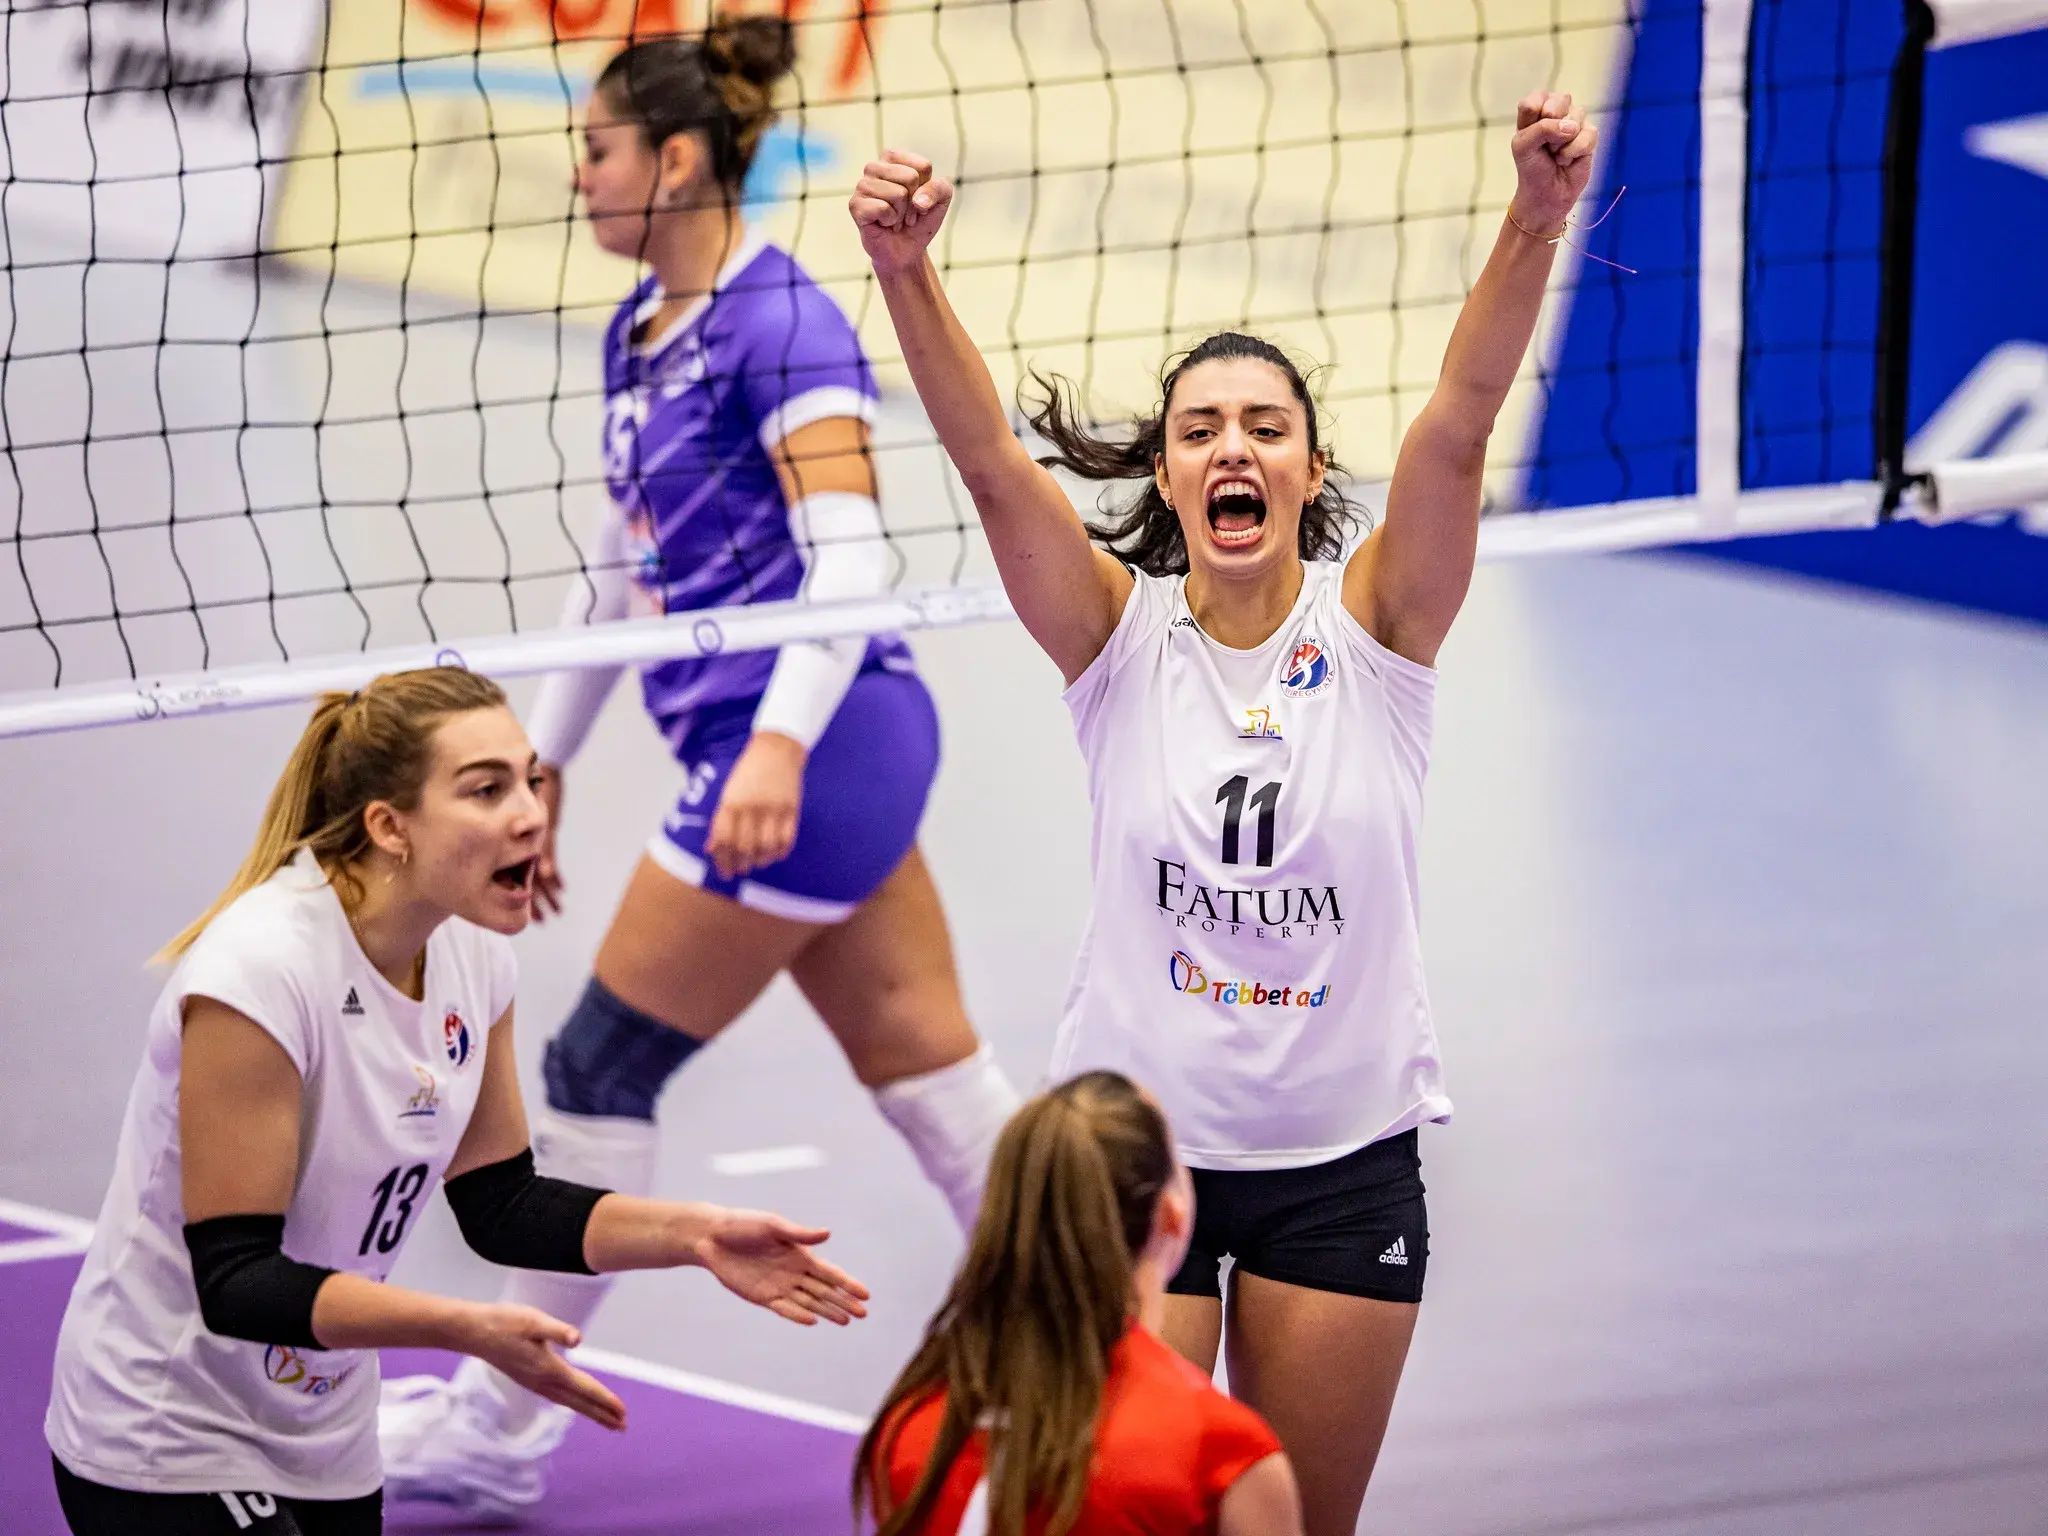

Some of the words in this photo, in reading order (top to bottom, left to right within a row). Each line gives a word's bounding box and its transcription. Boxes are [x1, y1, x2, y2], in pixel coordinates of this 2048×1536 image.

[1215, 774, 1282, 867] 11
[1158, 908, 1345, 939] ROPERTY
[1212, 981, 1292, 1006] Többet
[1296, 984, 1332, 1008] ad!
[359, 1163, 429, 1256] 13
[1379, 1252, 1408, 1266] adidas
